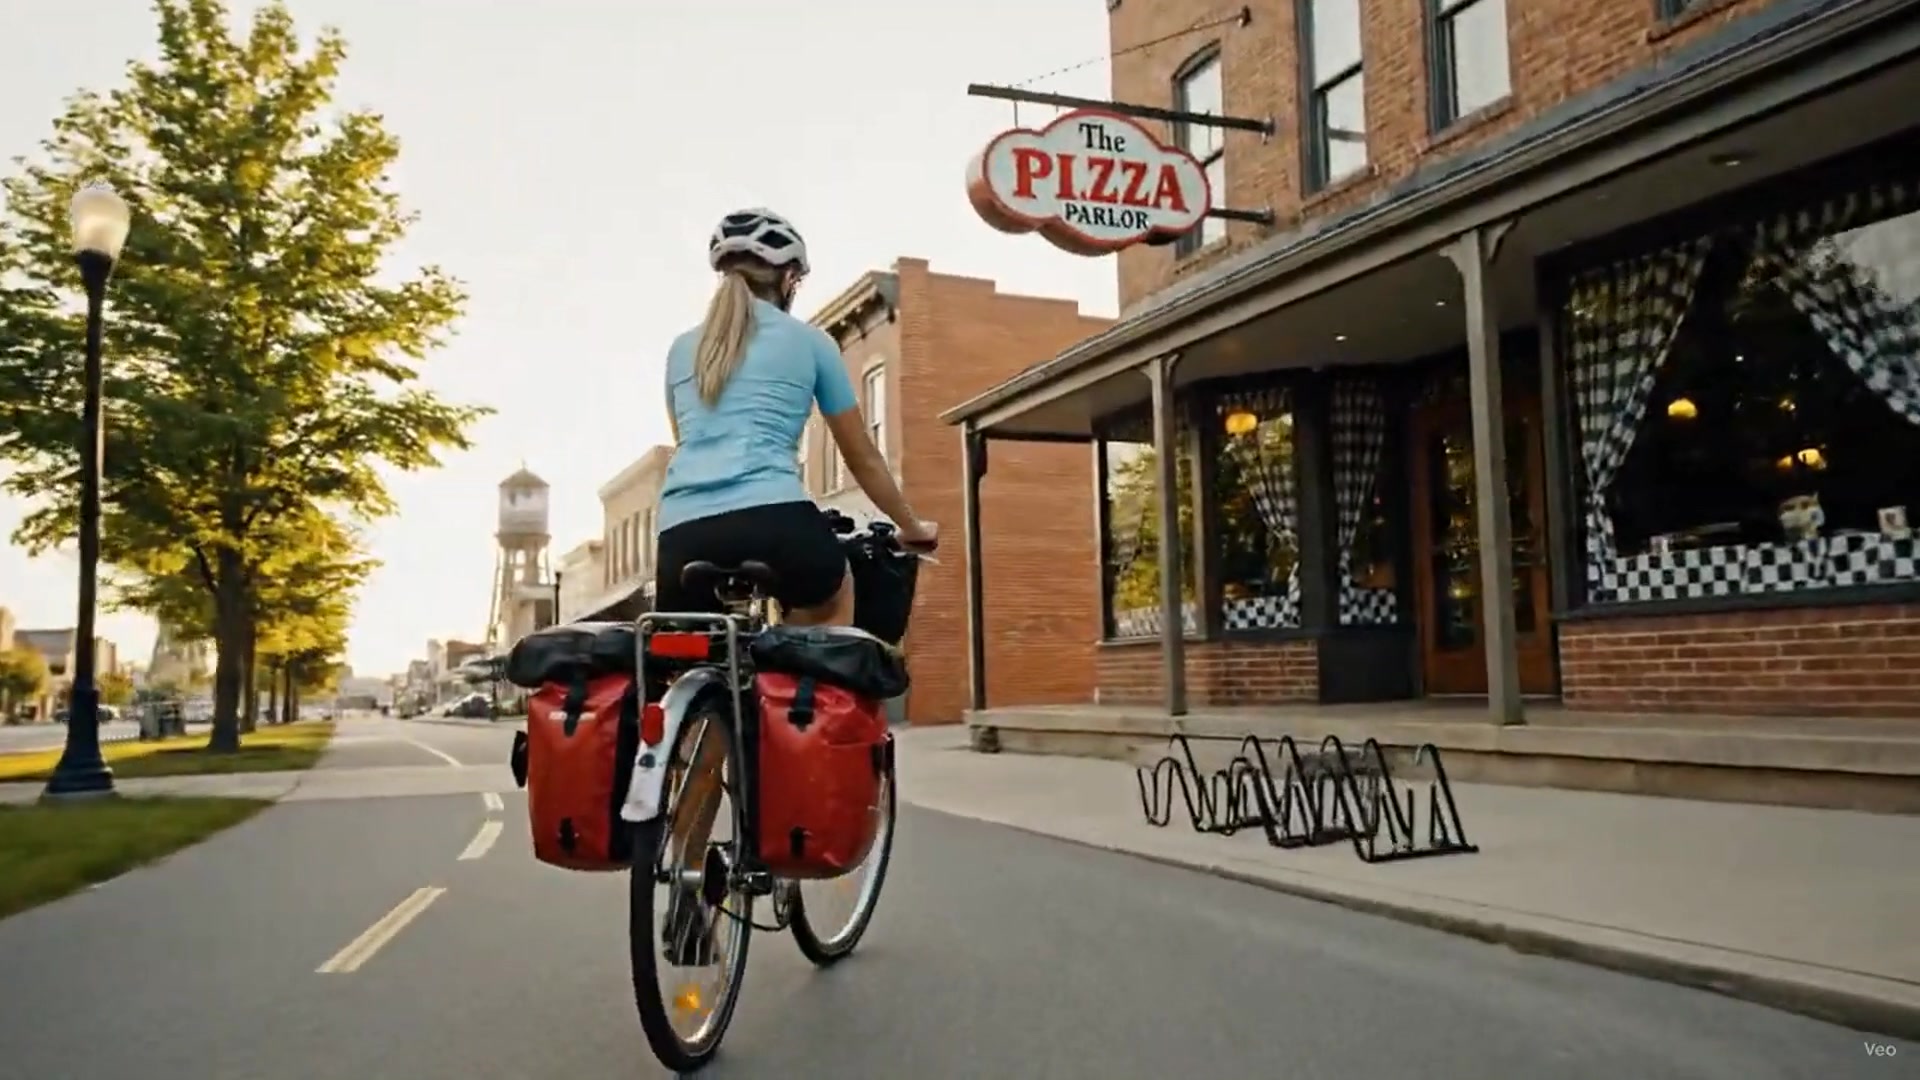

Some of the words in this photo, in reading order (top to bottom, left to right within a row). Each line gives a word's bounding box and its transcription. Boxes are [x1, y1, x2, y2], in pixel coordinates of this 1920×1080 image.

[1079, 122, 1126, 152] The
[1012, 147, 1190, 213] PIZZA
[1065, 202, 1149, 229] PARLOR
